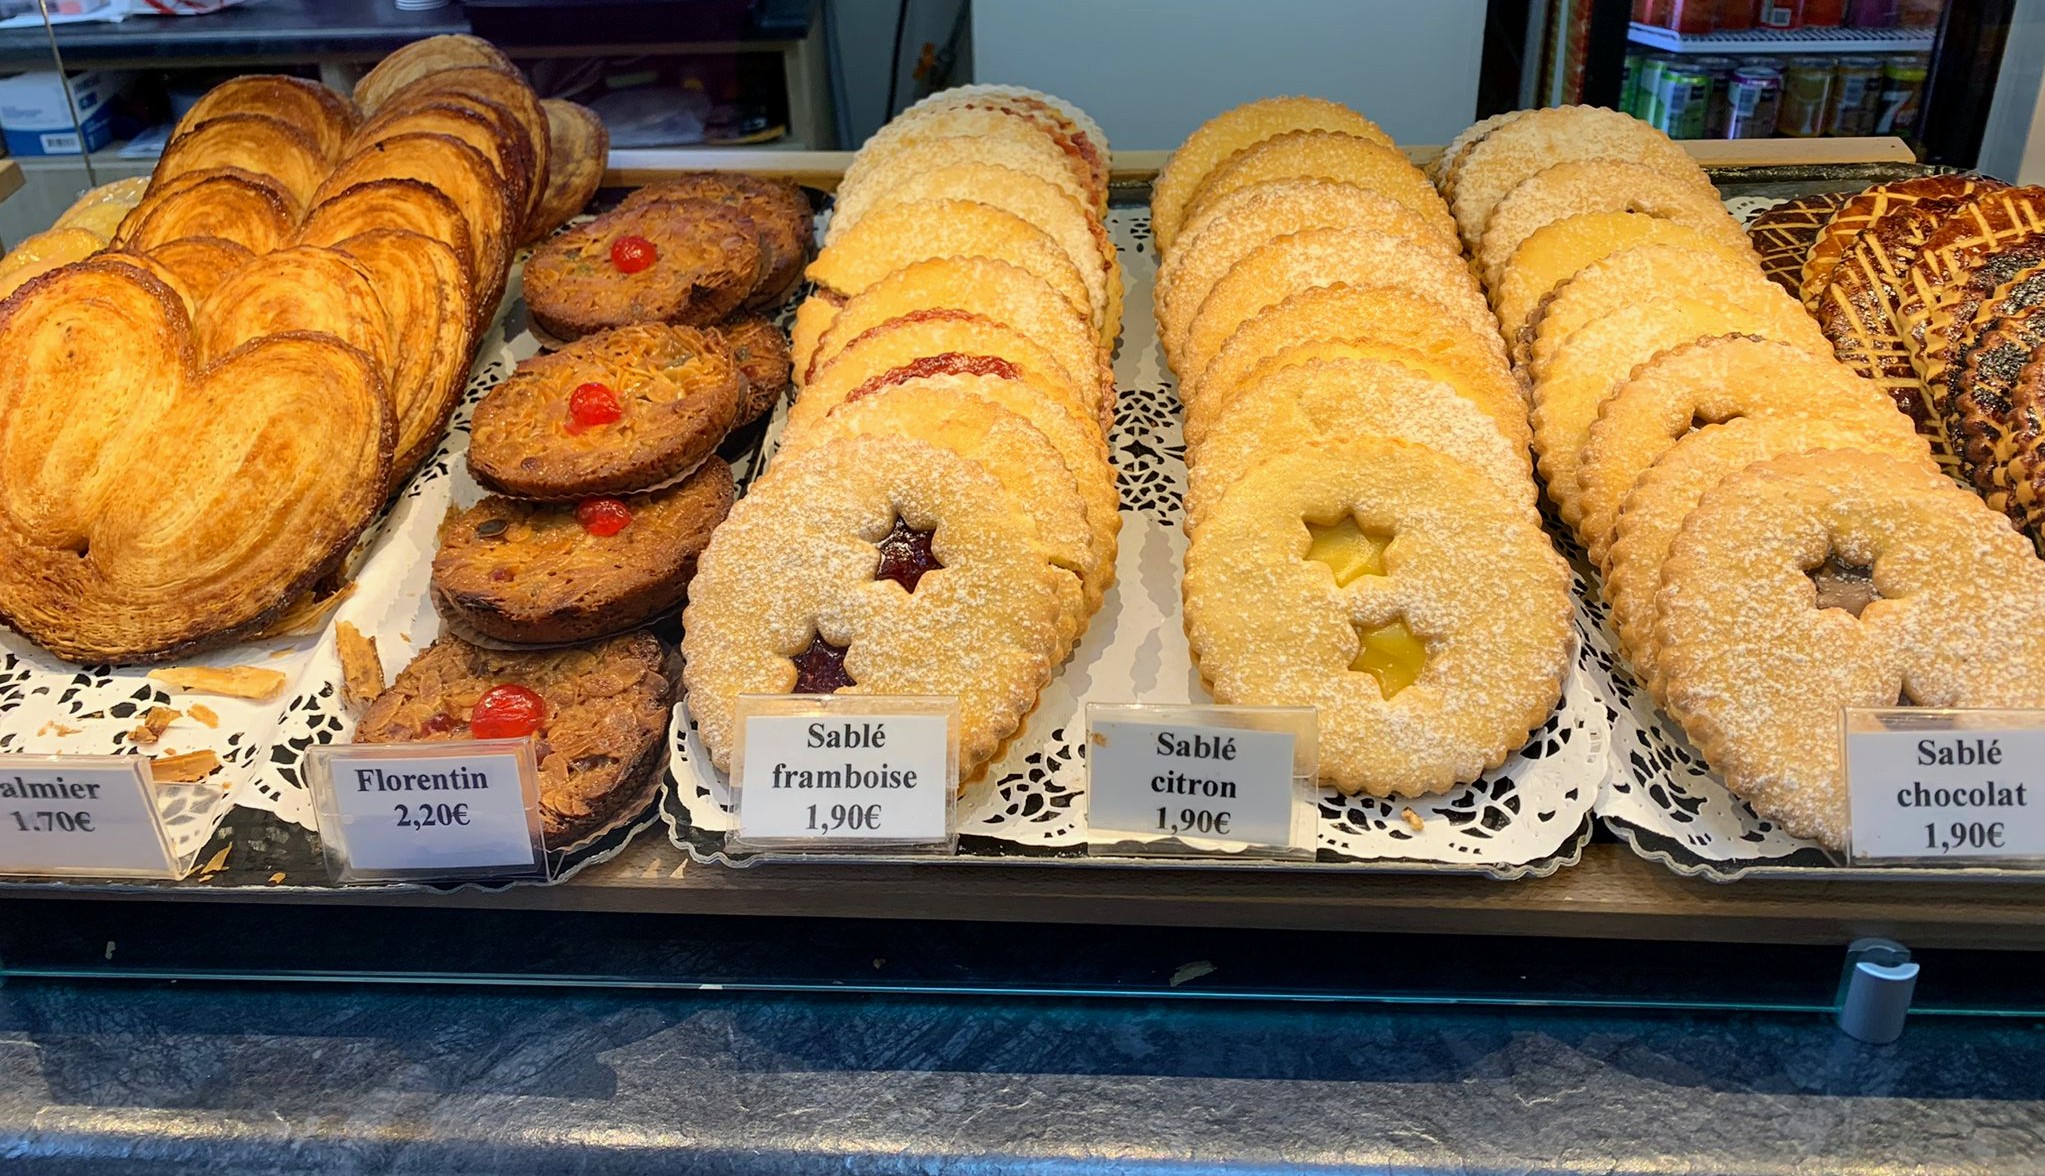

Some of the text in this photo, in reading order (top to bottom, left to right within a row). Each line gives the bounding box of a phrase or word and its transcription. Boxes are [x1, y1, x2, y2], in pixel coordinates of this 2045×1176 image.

[807, 722, 887, 750] Sablé
[1156, 731, 1237, 761] Sablé
[1917, 739, 2003, 766] Sablé
[0, 776, 101, 800] almier
[354, 766, 489, 793] Florentin
[772, 763, 917, 790] framboise
[1150, 769, 1237, 799] citron
[1897, 781, 2028, 807] chocolat
[10, 811, 96, 833] 1.70€
[393, 803, 471, 832] 2,20€
[806, 803, 882, 835] 1,90€
[1156, 806, 1231, 835] 1,90€
[1924, 822, 2006, 854] 1,90€
